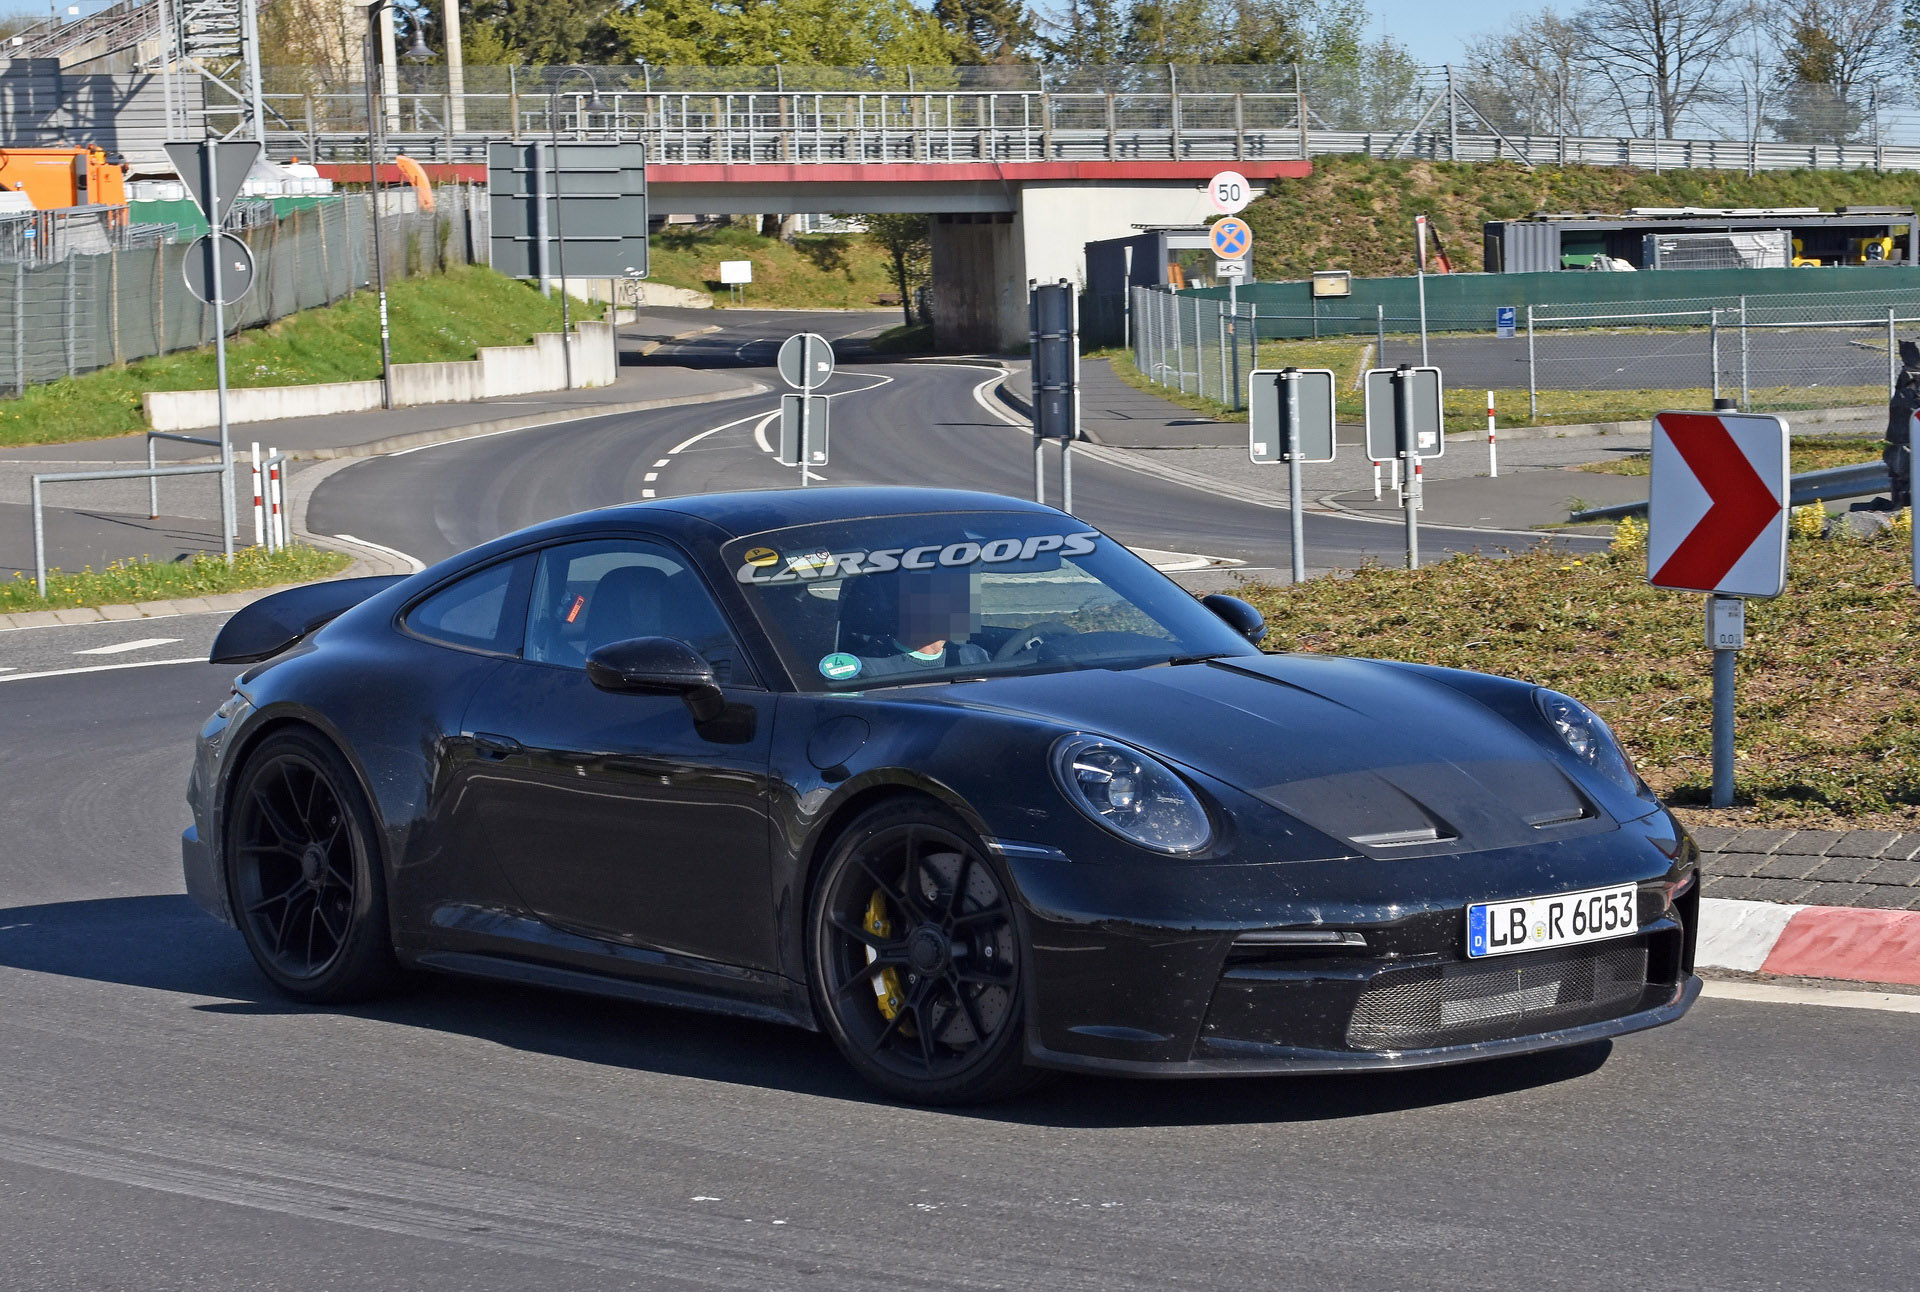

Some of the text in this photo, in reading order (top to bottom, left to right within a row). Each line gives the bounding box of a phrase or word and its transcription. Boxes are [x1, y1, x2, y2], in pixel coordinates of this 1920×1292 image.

[1219, 184, 1240, 202] 50
[834, 657, 844, 666] 4
[1490, 891, 1633, 947] LB R 6053
[1475, 935, 1482, 947] D
